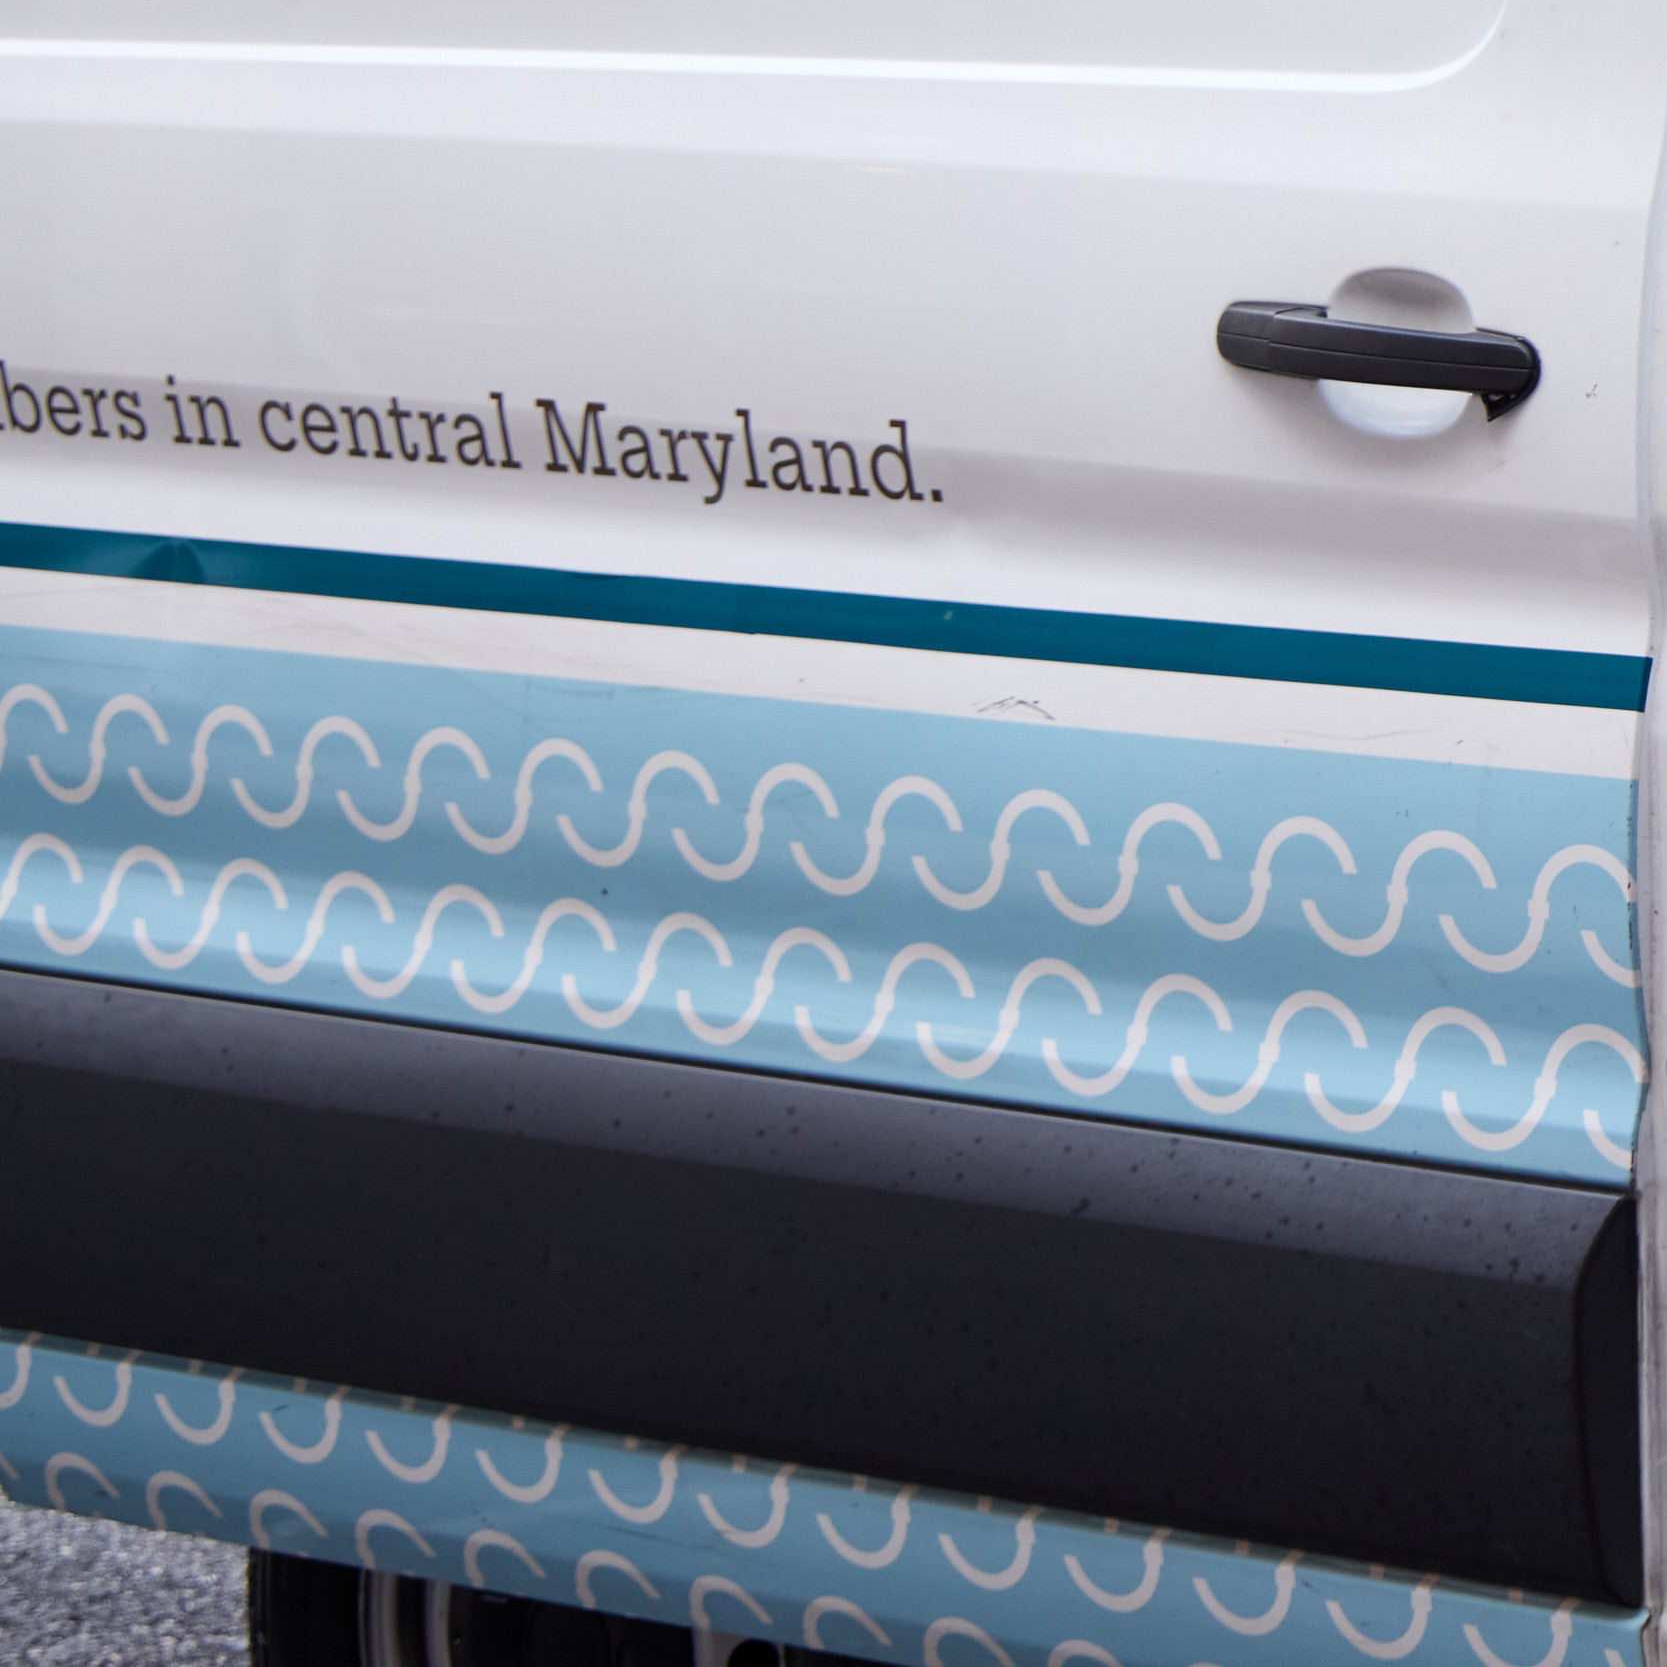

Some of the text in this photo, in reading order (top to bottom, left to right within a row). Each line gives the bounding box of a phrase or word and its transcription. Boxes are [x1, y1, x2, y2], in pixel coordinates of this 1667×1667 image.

[0, 359, 945, 505] bers in central Maryland.
